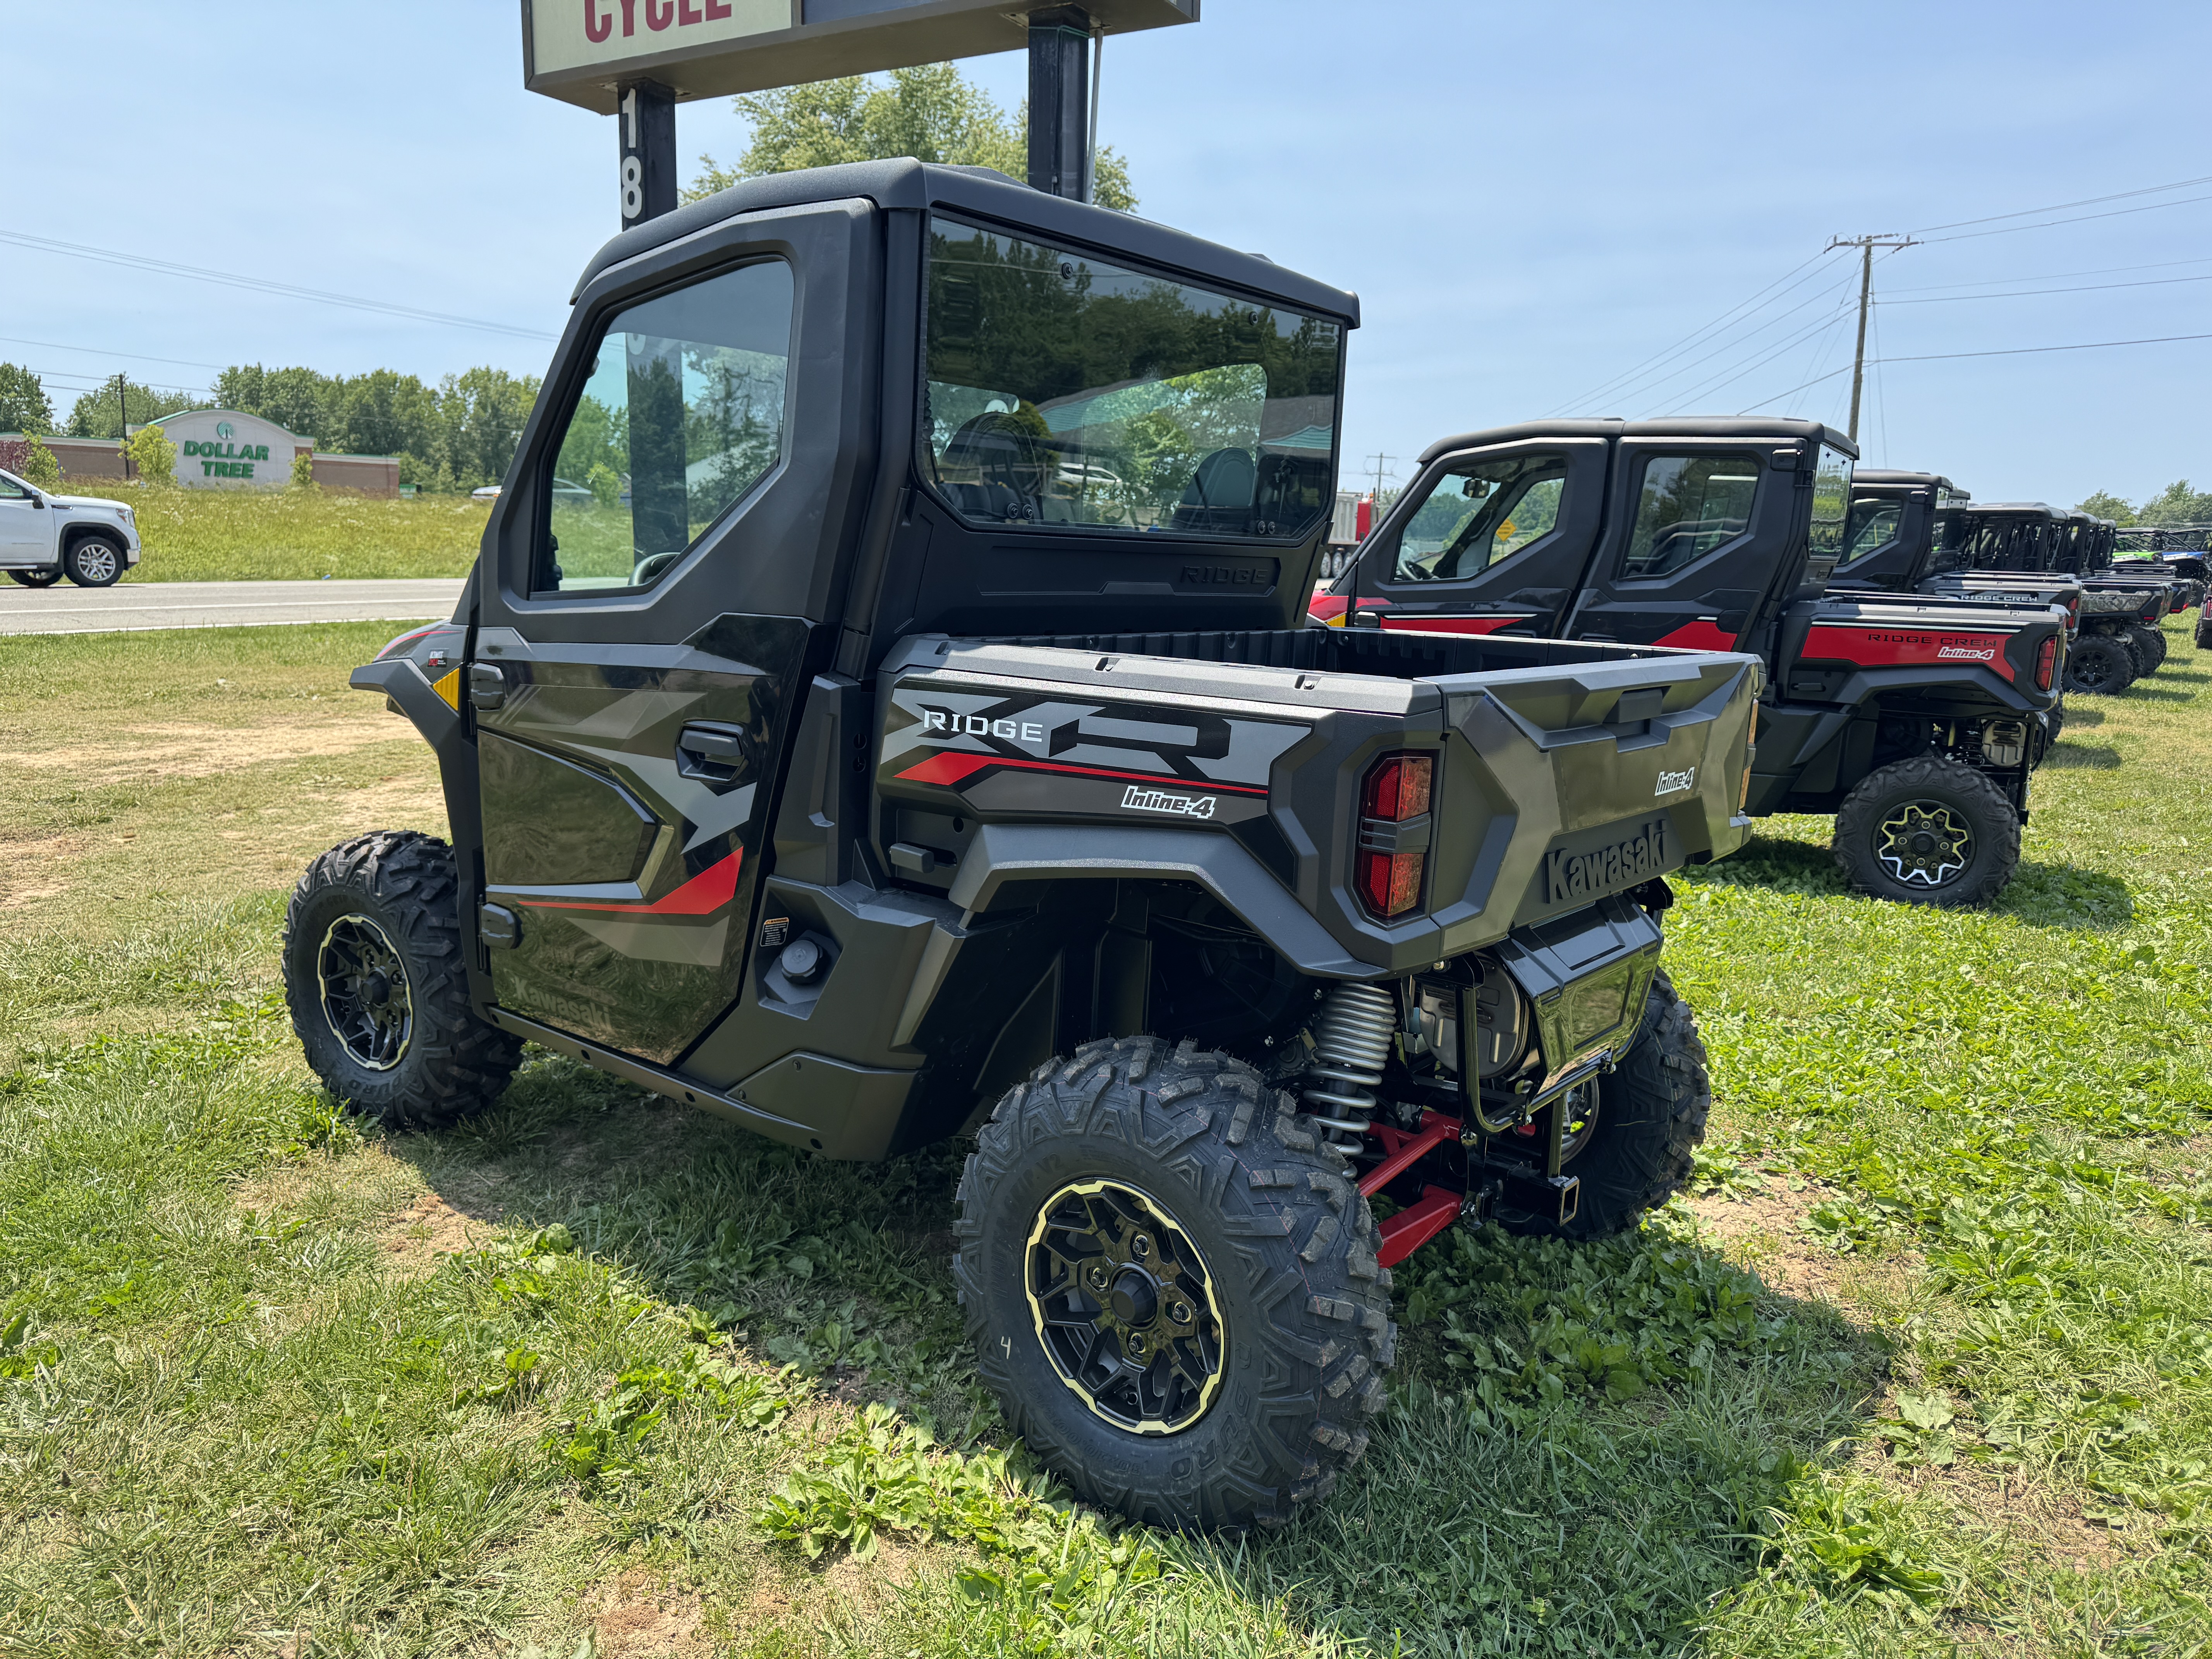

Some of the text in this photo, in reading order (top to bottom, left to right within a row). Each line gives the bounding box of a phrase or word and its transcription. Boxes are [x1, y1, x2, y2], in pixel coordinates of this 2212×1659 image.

[184, 440, 269, 461] DOLLAR
[201, 461, 255, 479] TREE
[1180, 565, 1269, 584] RIDGE
[1868, 634, 1997, 647] RIDGE CREW
[1937, 646, 1995, 660] Inline-4
[924, 710, 1043, 742] RIDGE
[1654, 767, 1695, 796] Inline-4
[1120, 785, 1216, 819] Inline-4
[1544, 819, 1667, 904] Kawasaki
[514, 975, 613, 1031] Kawasaki
[348, 1072, 402, 1096] DURO
[1034, 1151, 1065, 1175] V2
[1000, 1336, 1011, 1360] 4
[1171, 1379, 1250, 1481] DURO
